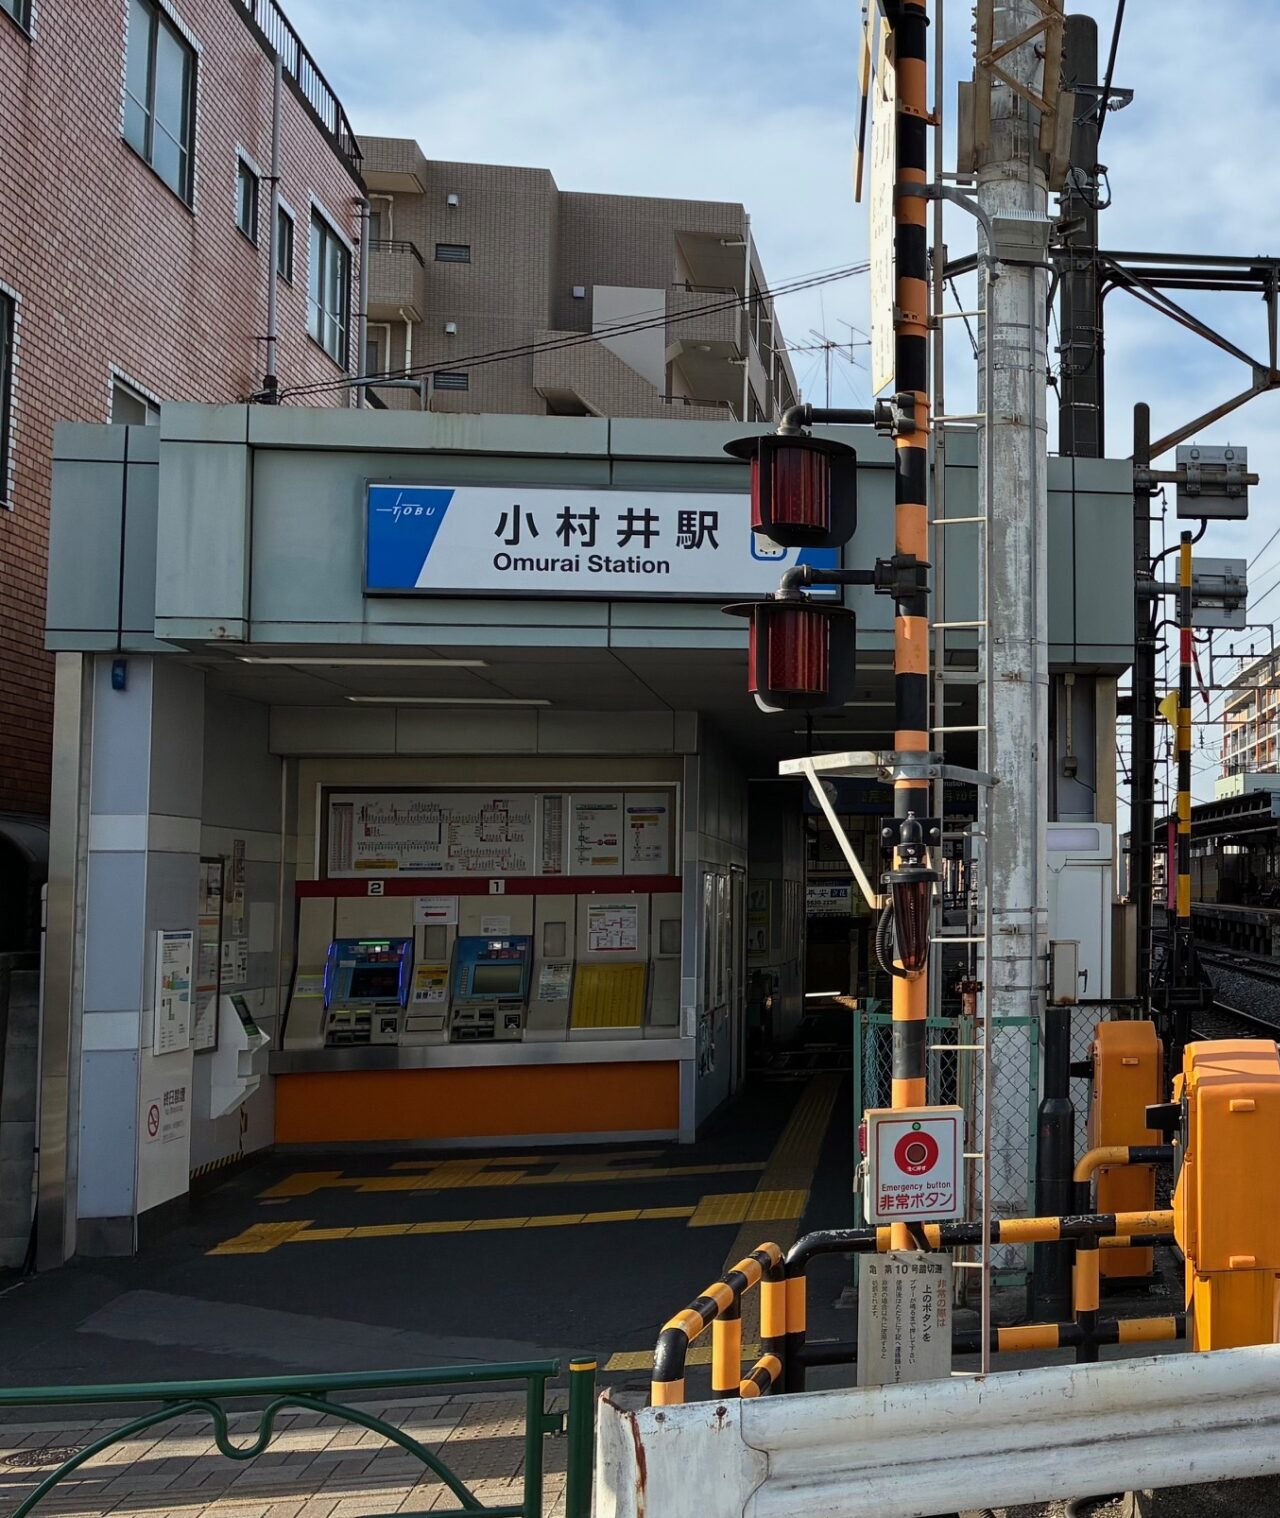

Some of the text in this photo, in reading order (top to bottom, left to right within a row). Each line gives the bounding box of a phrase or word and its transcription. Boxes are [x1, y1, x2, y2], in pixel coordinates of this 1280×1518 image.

[390, 504, 436, 517] TOBU
[494, 504, 720, 550] 小村井駅
[493, 552, 670, 574] Omurai Station
[371, 883, 381, 893] 2
[494, 881, 500, 892] 1
[881, 1181, 951, 1192] Emergency button
[880, 1192, 953, 1211] 非常ボタン
[922, 1284, 932, 1342] 上のボタンを
[937, 1279, 947, 1328] 非常の際は
